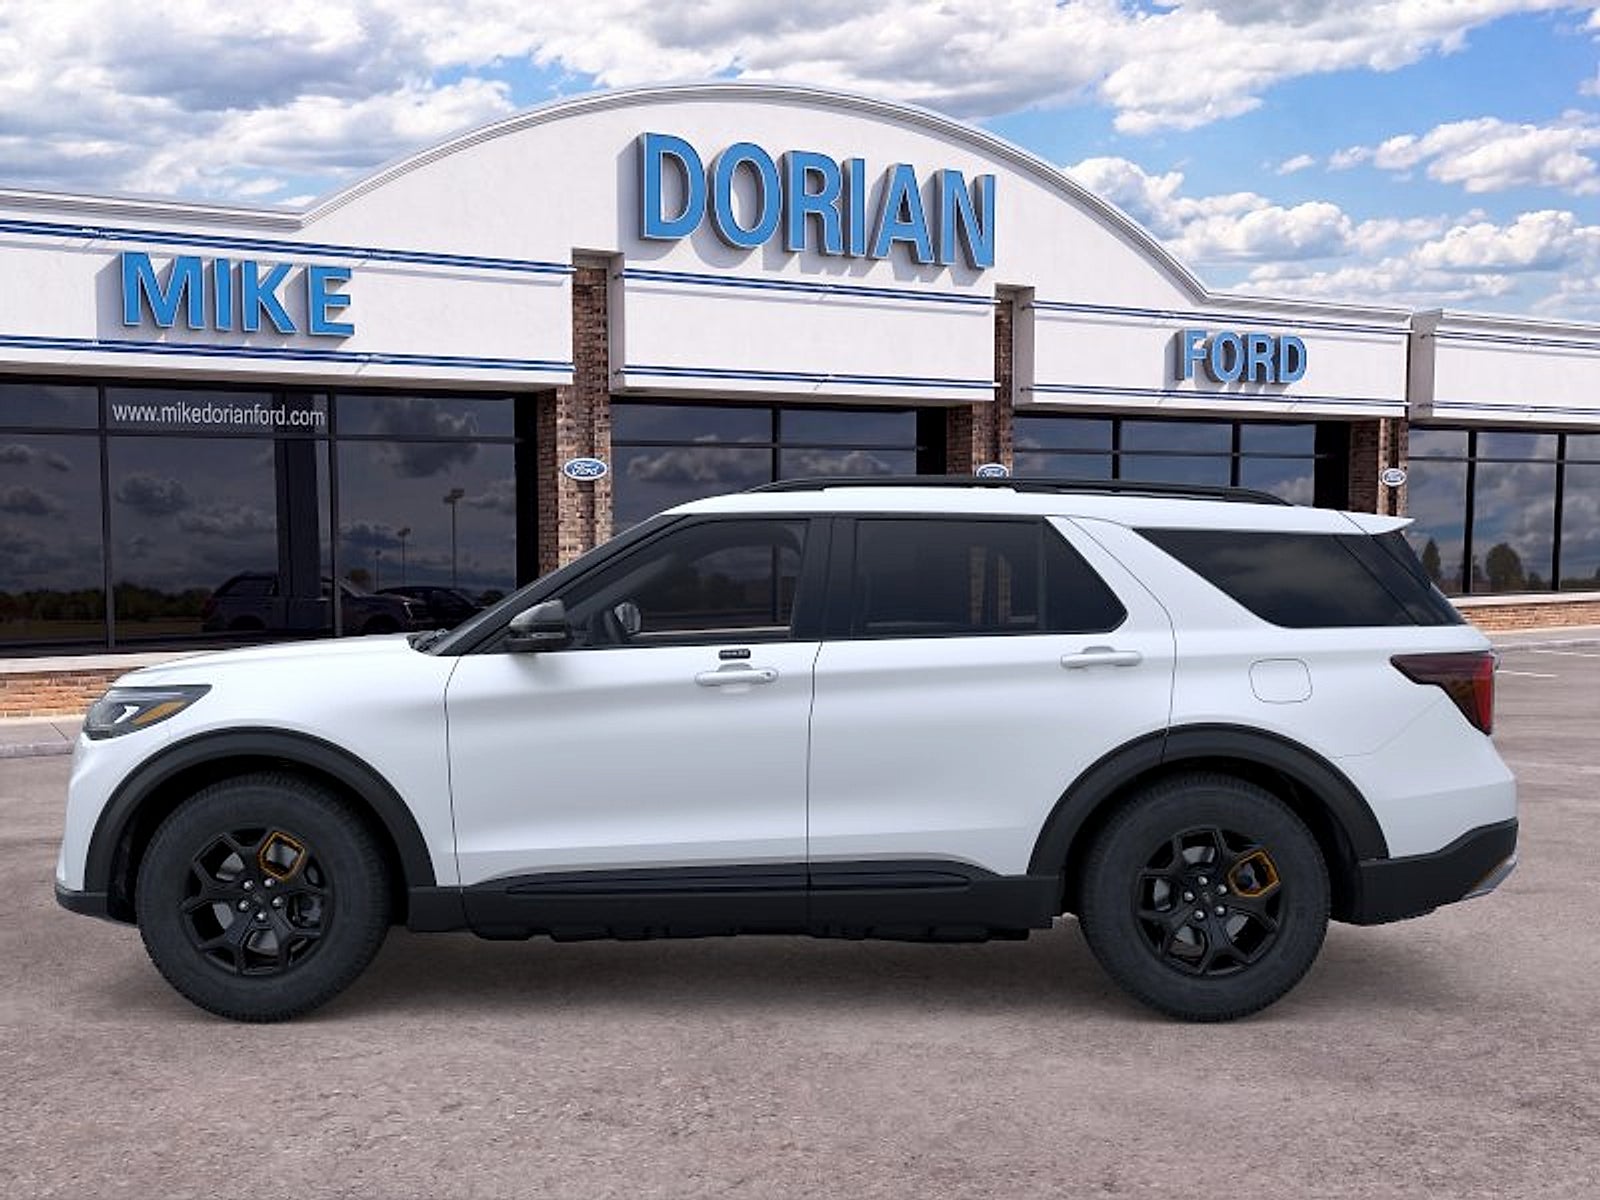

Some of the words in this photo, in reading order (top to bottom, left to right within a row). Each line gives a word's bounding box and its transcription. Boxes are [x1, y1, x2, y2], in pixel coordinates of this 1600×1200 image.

[639, 132, 996, 268] DORIAN
[121, 252, 355, 336] MIKE
[1178, 329, 1307, 385] FORD
[112, 402, 326, 426] www.mikedorianford.com
